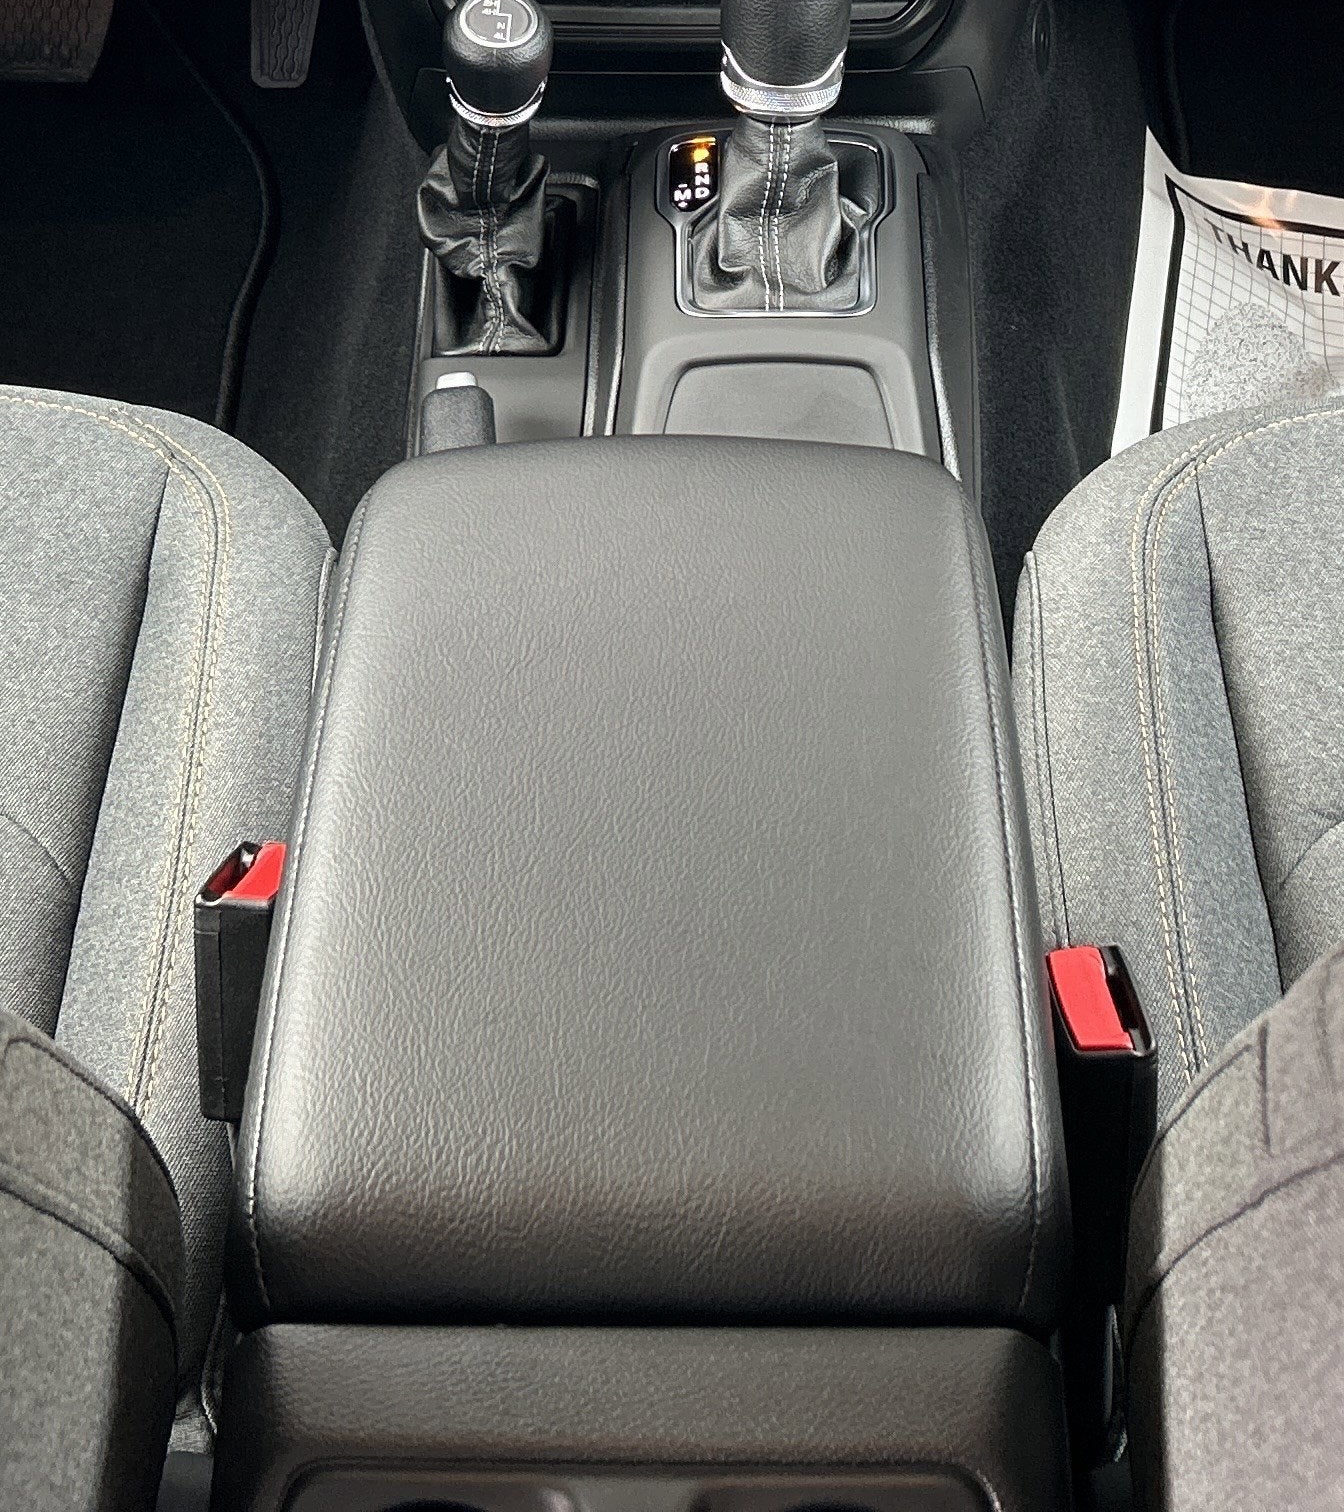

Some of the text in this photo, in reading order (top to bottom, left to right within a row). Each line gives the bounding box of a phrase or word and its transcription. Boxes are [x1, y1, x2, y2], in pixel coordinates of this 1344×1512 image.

[695, 174, 710, 185] N
[674, 188, 691, 201] M
[695, 187, 710, 199] D
